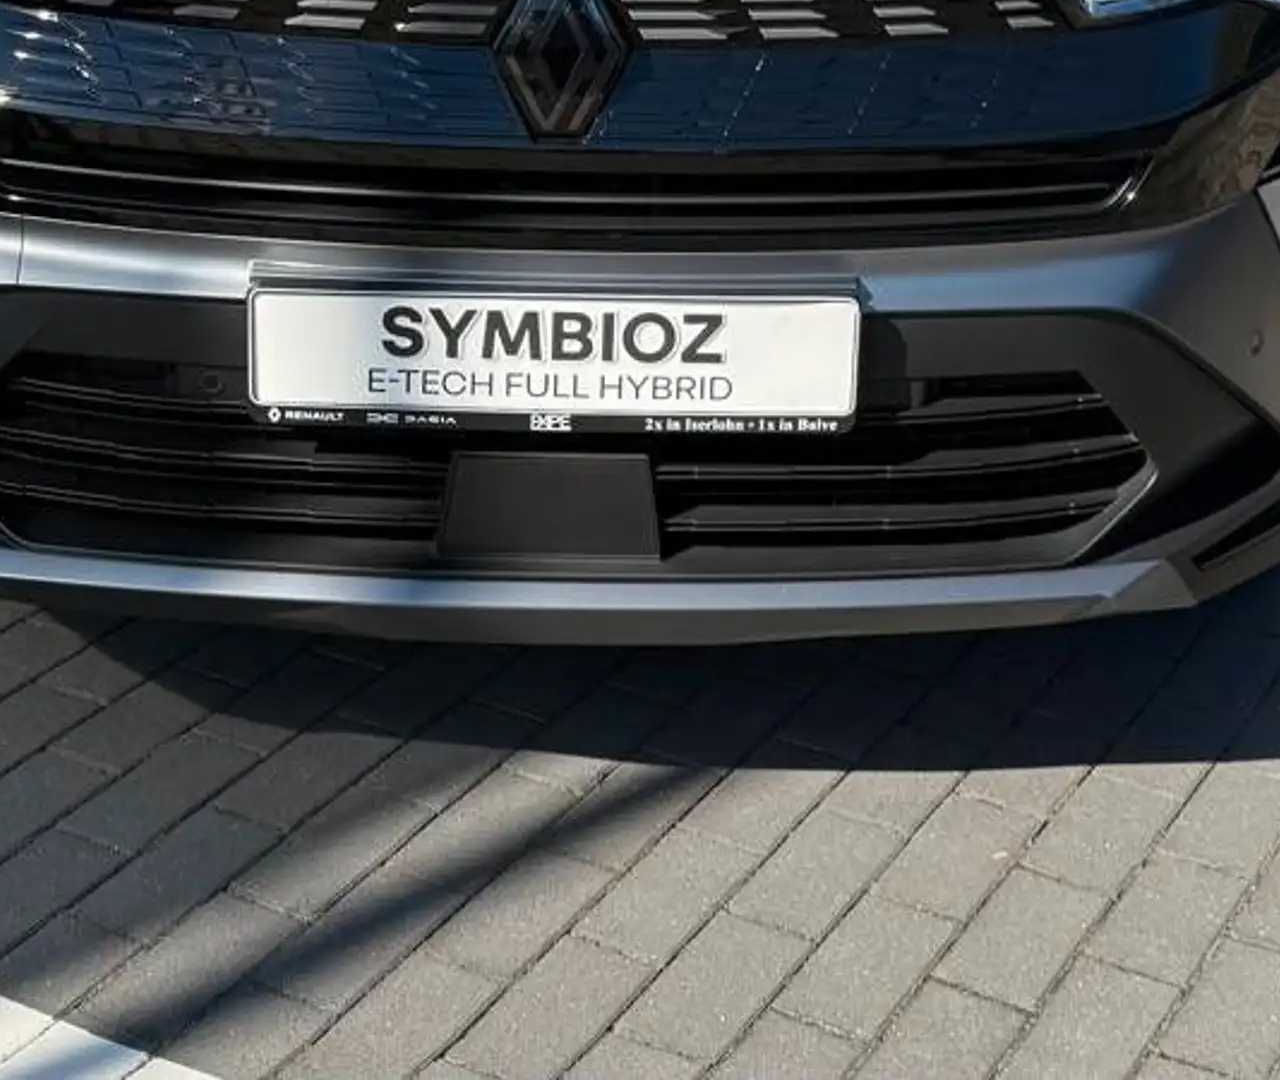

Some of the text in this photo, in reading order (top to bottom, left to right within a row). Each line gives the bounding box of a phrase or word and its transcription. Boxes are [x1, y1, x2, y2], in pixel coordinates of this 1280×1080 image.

[381, 306, 724, 364] SYMBIOZ
[367, 367, 734, 402] E-TECH FULL HYBRID
[284, 410, 345, 422] RENAULT
[644, 418, 663, 431] 2x
[666, 418, 681, 431] in
[778, 418, 794, 432] in
